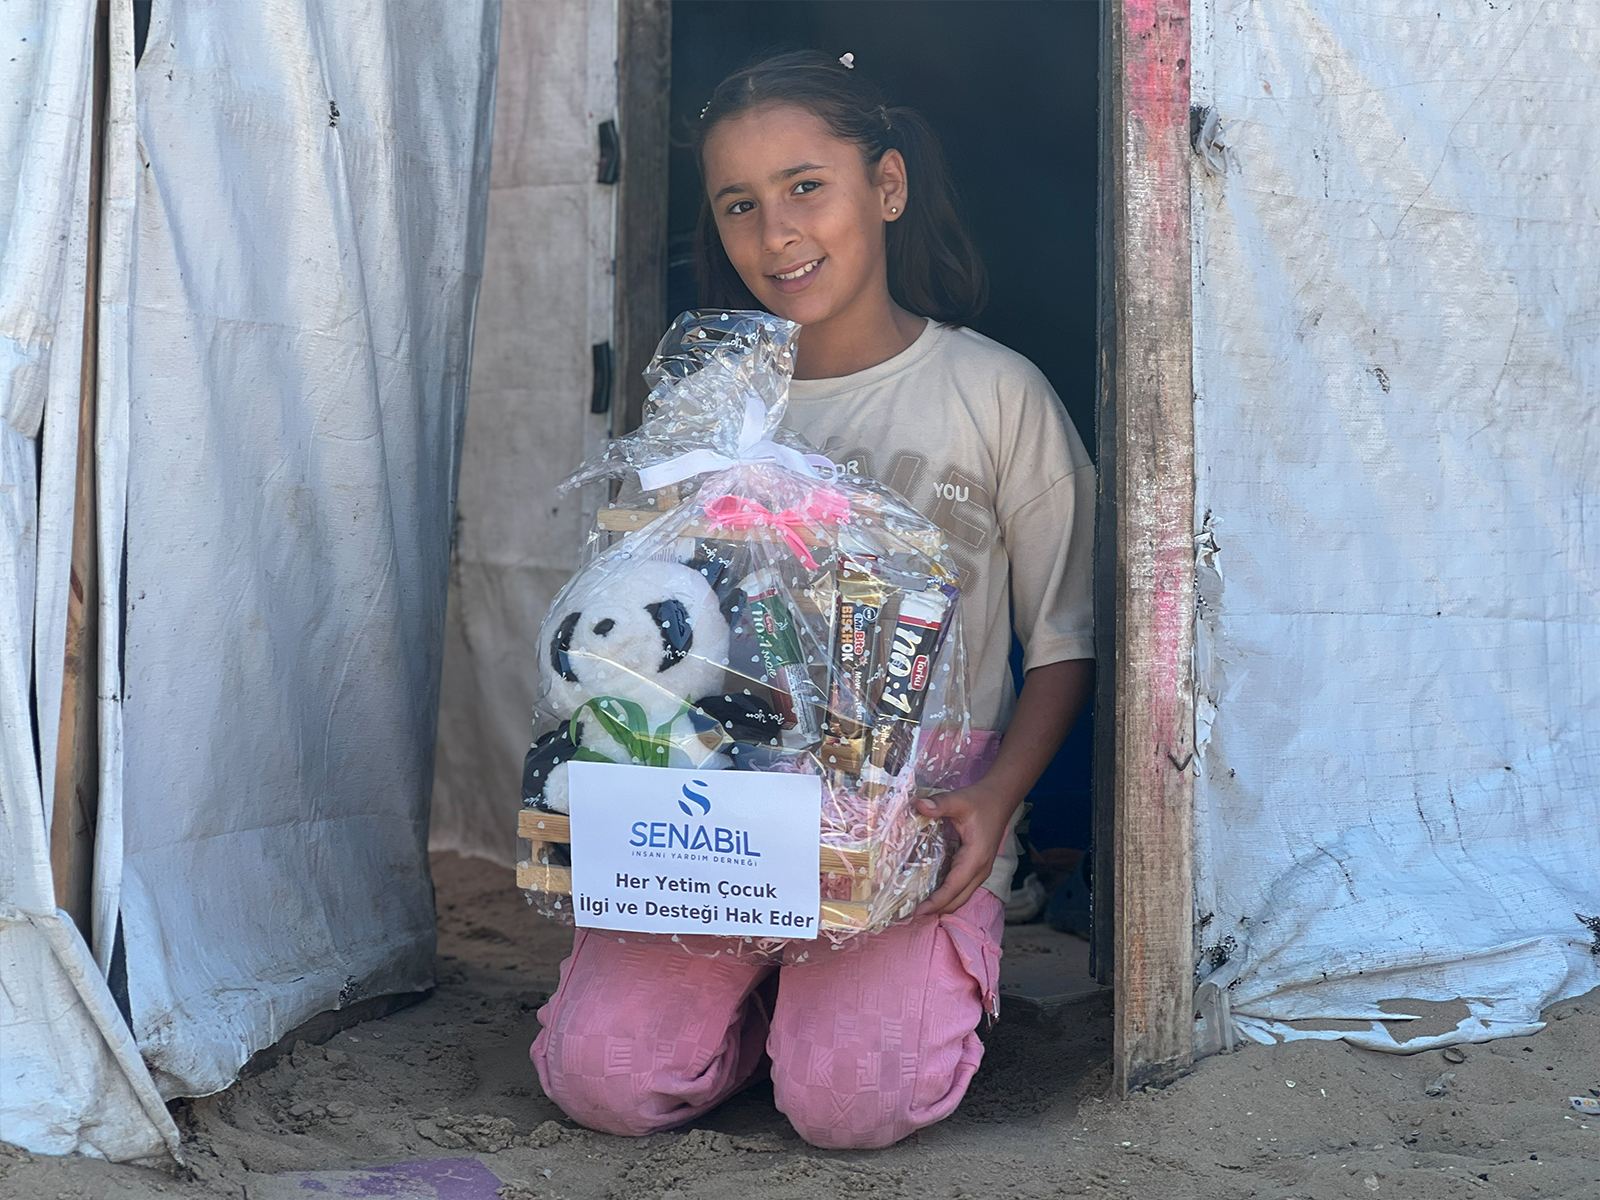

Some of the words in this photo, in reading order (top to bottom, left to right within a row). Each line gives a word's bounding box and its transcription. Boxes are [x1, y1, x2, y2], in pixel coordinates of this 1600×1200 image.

[933, 482, 969, 502] YOU
[913, 659, 927, 688] Torku
[671, 852, 709, 862] YARDIM
[616, 872, 650, 890] Her
[655, 875, 711, 894] Yetim
[718, 880, 778, 899] Çocuk
[580, 892, 609, 916] İlgi
[616, 902, 638, 915] ve
[645, 901, 718, 924] Desteği
[726, 906, 763, 925] Hak
[770, 910, 815, 928] Eder
